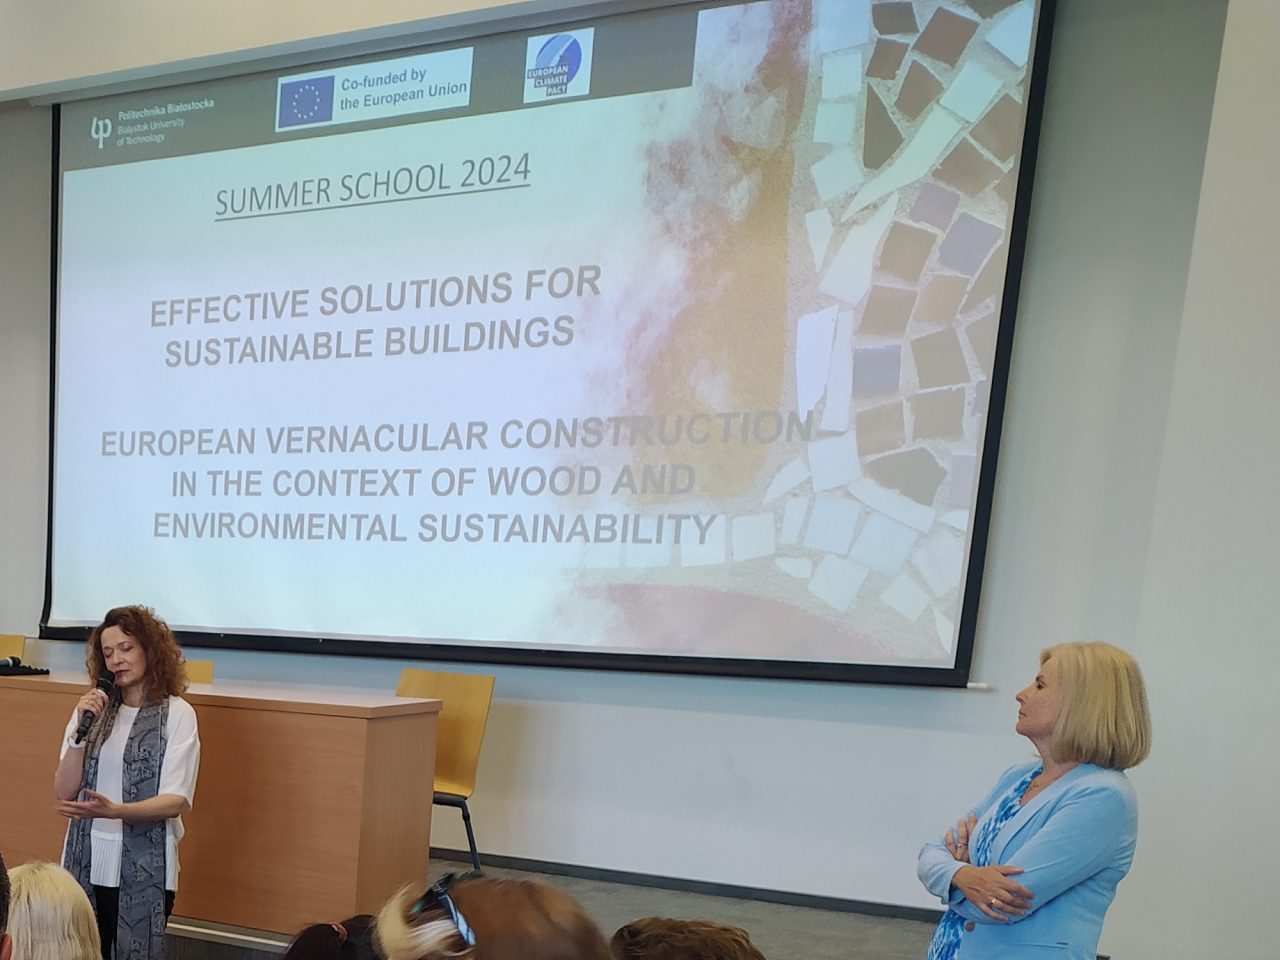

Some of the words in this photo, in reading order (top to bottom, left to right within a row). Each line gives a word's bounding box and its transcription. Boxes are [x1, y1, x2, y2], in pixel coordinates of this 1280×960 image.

[341, 69, 407, 91] Co-funded
[410, 68, 427, 83] by
[528, 65, 569, 78] EUROPEAN
[535, 74, 568, 87] CLIMATE
[340, 98, 360, 110] the
[363, 88, 424, 107] European
[428, 82, 467, 97] Union
[547, 86, 567, 95] PACT
[215, 177, 331, 216] SUMMER
[339, 162, 451, 202] SCHOOL
[460, 152, 531, 188] 2024
[150, 289, 310, 328] EFFECTIVE
[319, 272, 513, 317] SOLUTIONS
[525, 264, 603, 301] FOR
[165, 328, 375, 368] SUSTAINABLE
[384, 314, 576, 357] BUILDINGS
[101, 427, 256, 457] EUROPEAN
[265, 421, 489, 454] VERNACULAR
[500, 409, 814, 450] CONSTRUCTION
[171, 471, 197, 497] IN
[206, 470, 263, 497] THE
[272, 468, 422, 498] CONTEXT
[430, 467, 477, 497] OF
[487, 466, 602, 497] WOOD
[611, 463, 696, 495] AND
[153, 512, 408, 542] ENVIRONMENTAL
[417, 512, 718, 545] SUSTAINABILITY
